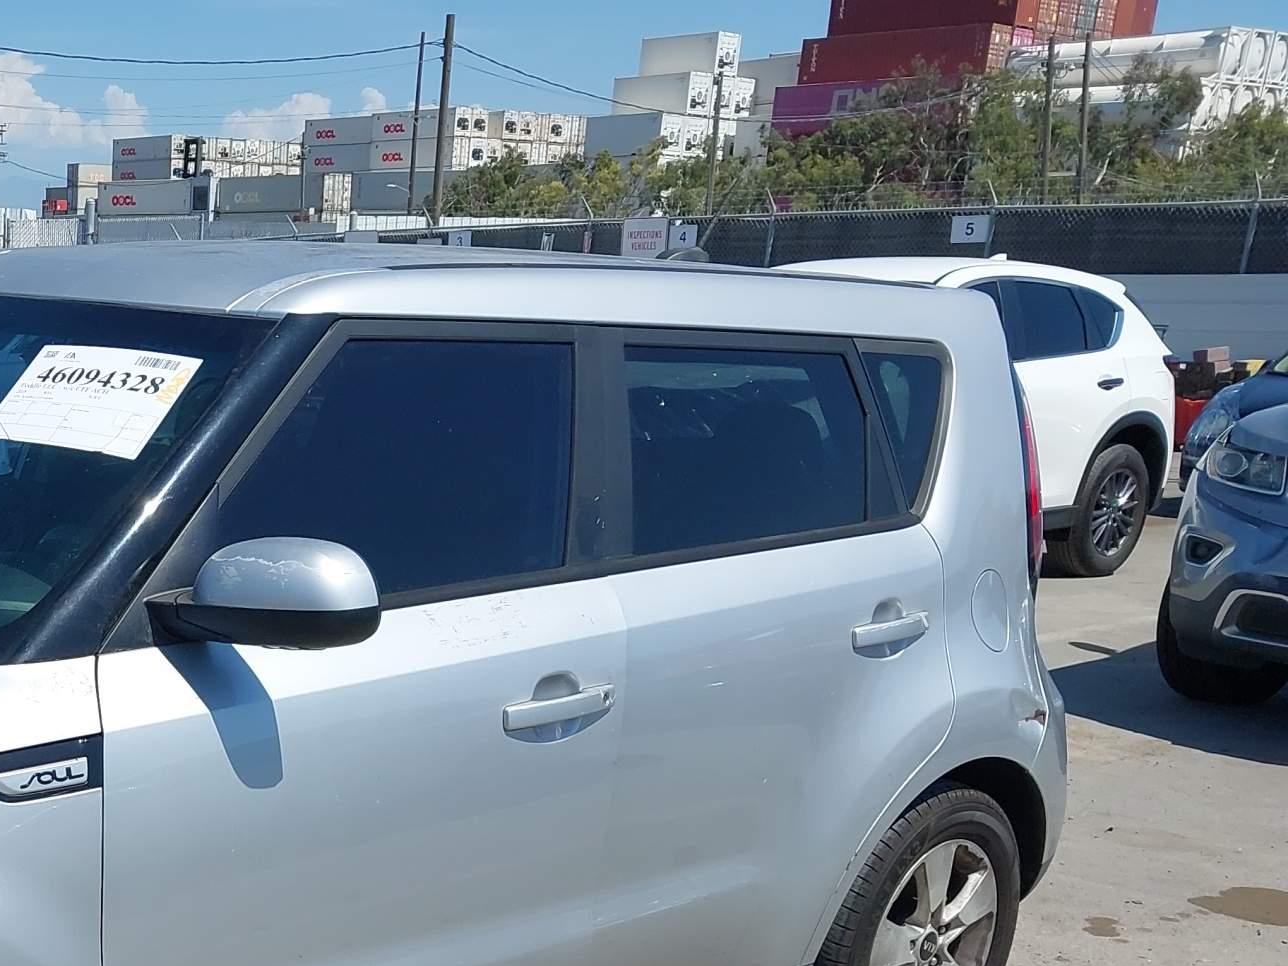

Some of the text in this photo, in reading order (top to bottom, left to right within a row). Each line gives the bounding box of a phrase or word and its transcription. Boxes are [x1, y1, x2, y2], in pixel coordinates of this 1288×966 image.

[383, 123, 406, 134] OOCL
[315, 129, 337, 140] OOCL
[314, 156, 335, 167] OOCL
[381, 152, 404, 163] OOCL
[111, 195, 137, 206] OOCL
[964, 222, 975, 236] 5
[679, 231, 687, 244] 4
[36, 365, 165, 395] 46094328
[19, 766, 85, 790] SOUL
